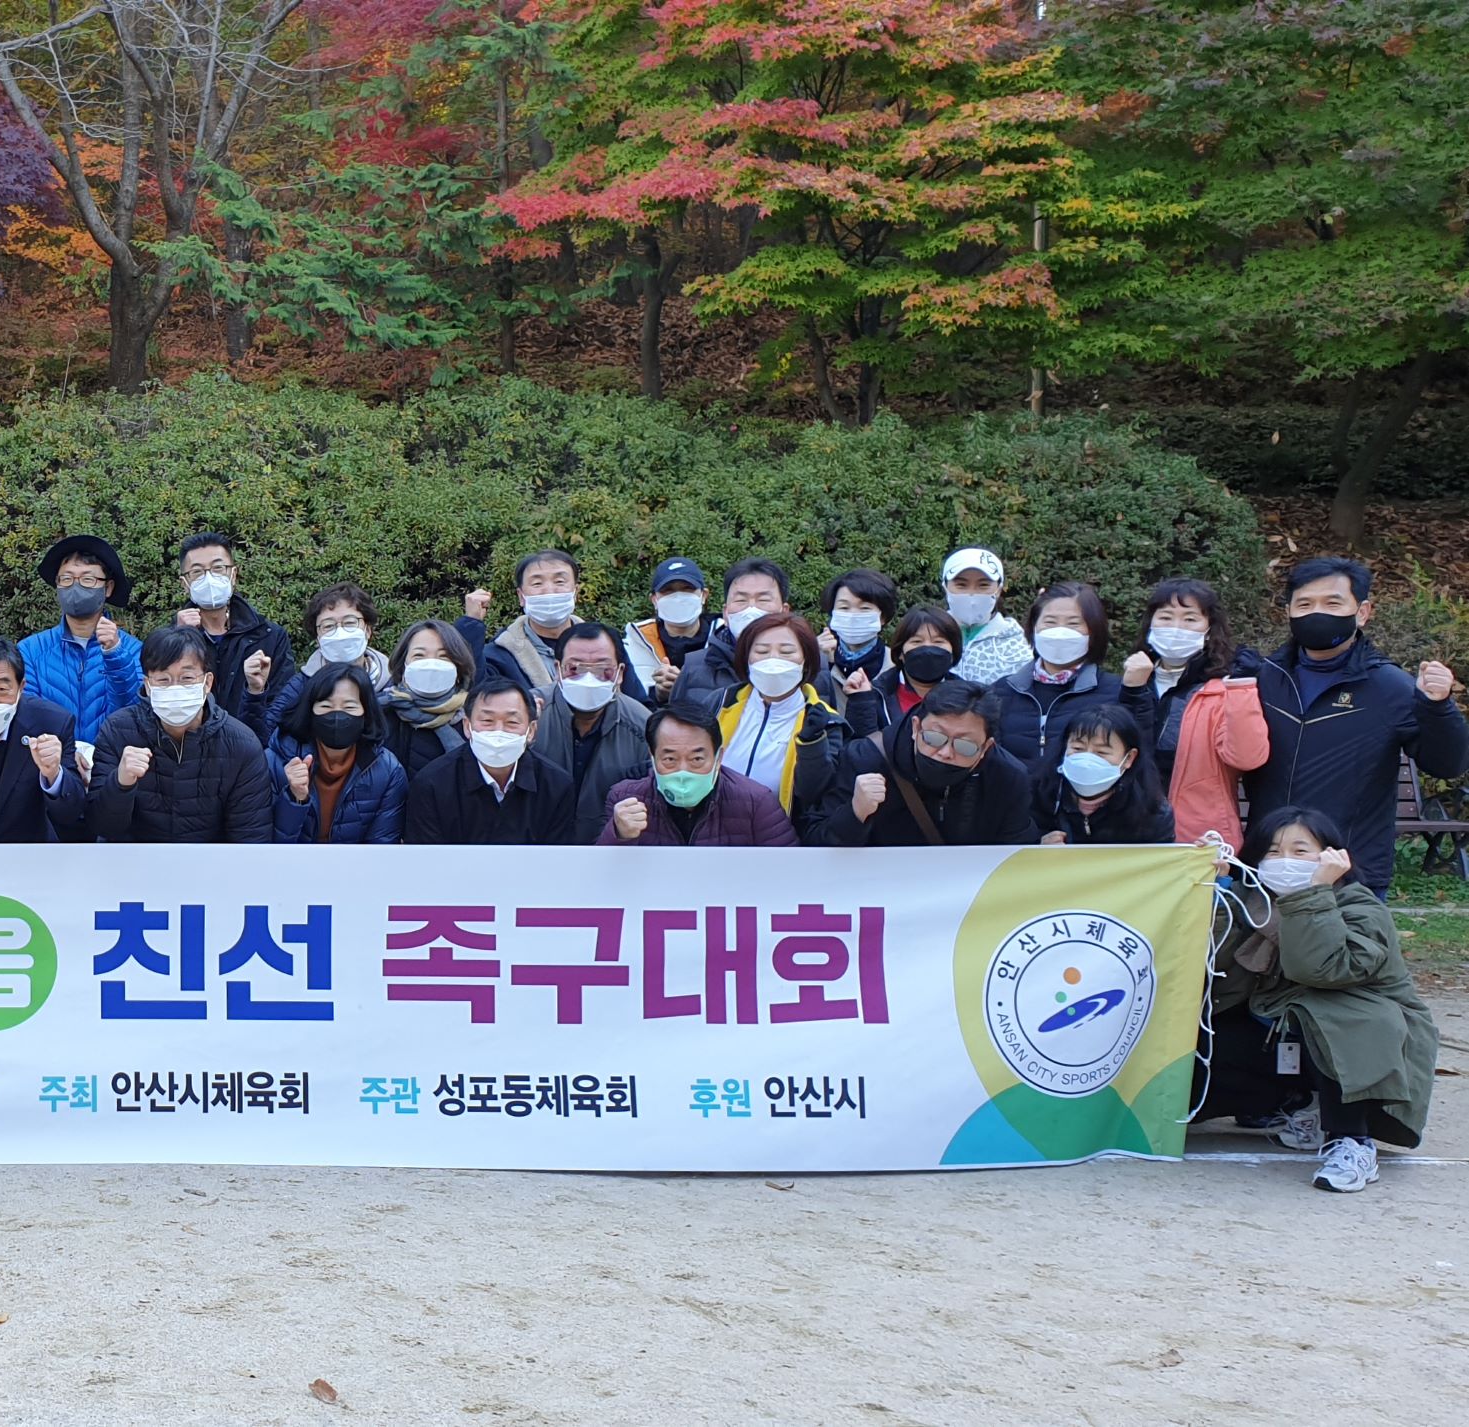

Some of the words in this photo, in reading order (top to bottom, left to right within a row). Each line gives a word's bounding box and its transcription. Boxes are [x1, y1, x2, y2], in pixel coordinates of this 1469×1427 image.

[92, 901, 335, 1022] 친선
[382, 903, 890, 1025] 족구대회
[996, 1012, 1029, 1062] ANSAN
[1026, 1060, 1059, 1083] CITY
[1060, 1063, 1111, 1086] SPORTS
[1112, 1004, 1145, 1065] COUNCIL
[38, 1074, 98, 1113] 주최
[111, 1071, 310, 1115] 안산시체육회
[359, 1076, 421, 1115] 주관
[432, 1073, 638, 1119] 성포동체육회
[689, 1078, 752, 1119] 후원
[763, 1075, 867, 1119] 안산시
